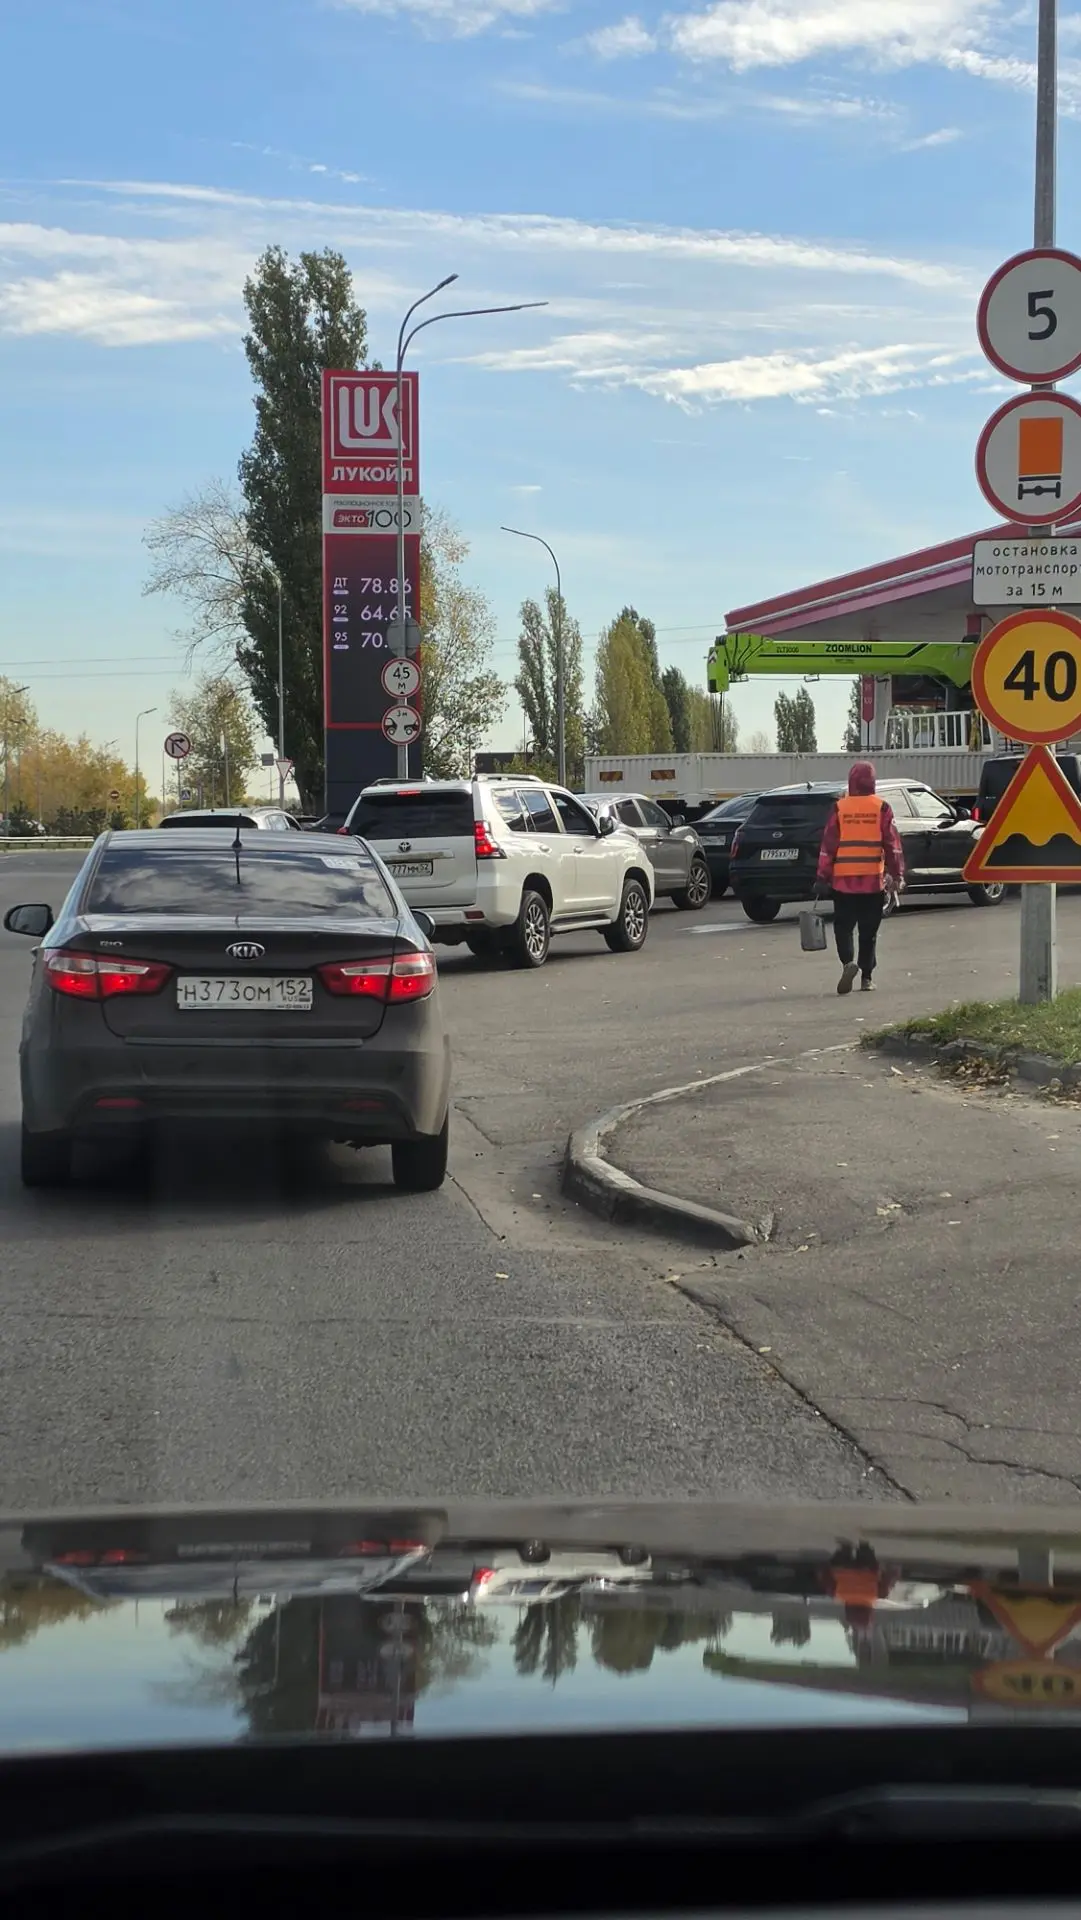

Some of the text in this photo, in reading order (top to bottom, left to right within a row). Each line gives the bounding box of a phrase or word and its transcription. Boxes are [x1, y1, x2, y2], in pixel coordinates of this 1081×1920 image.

[1028, 290, 1057, 340] 5
[331, 464, 413, 482] ЛУКОЙЛ
[338, 509, 412, 528] ЭКТО 100
[993, 545, 1077, 557] остановка
[334, 577, 412, 594] ДТ 78.86
[1006, 583, 1063, 597] за 15 м
[334, 605, 347, 614] 92
[334, 632, 348, 641] 95
[826, 644, 872, 653] ZOOMLION
[1004, 650, 1077, 702] 40
[232, 946, 259, 957] KIA
[276, 980, 307, 996] 152
